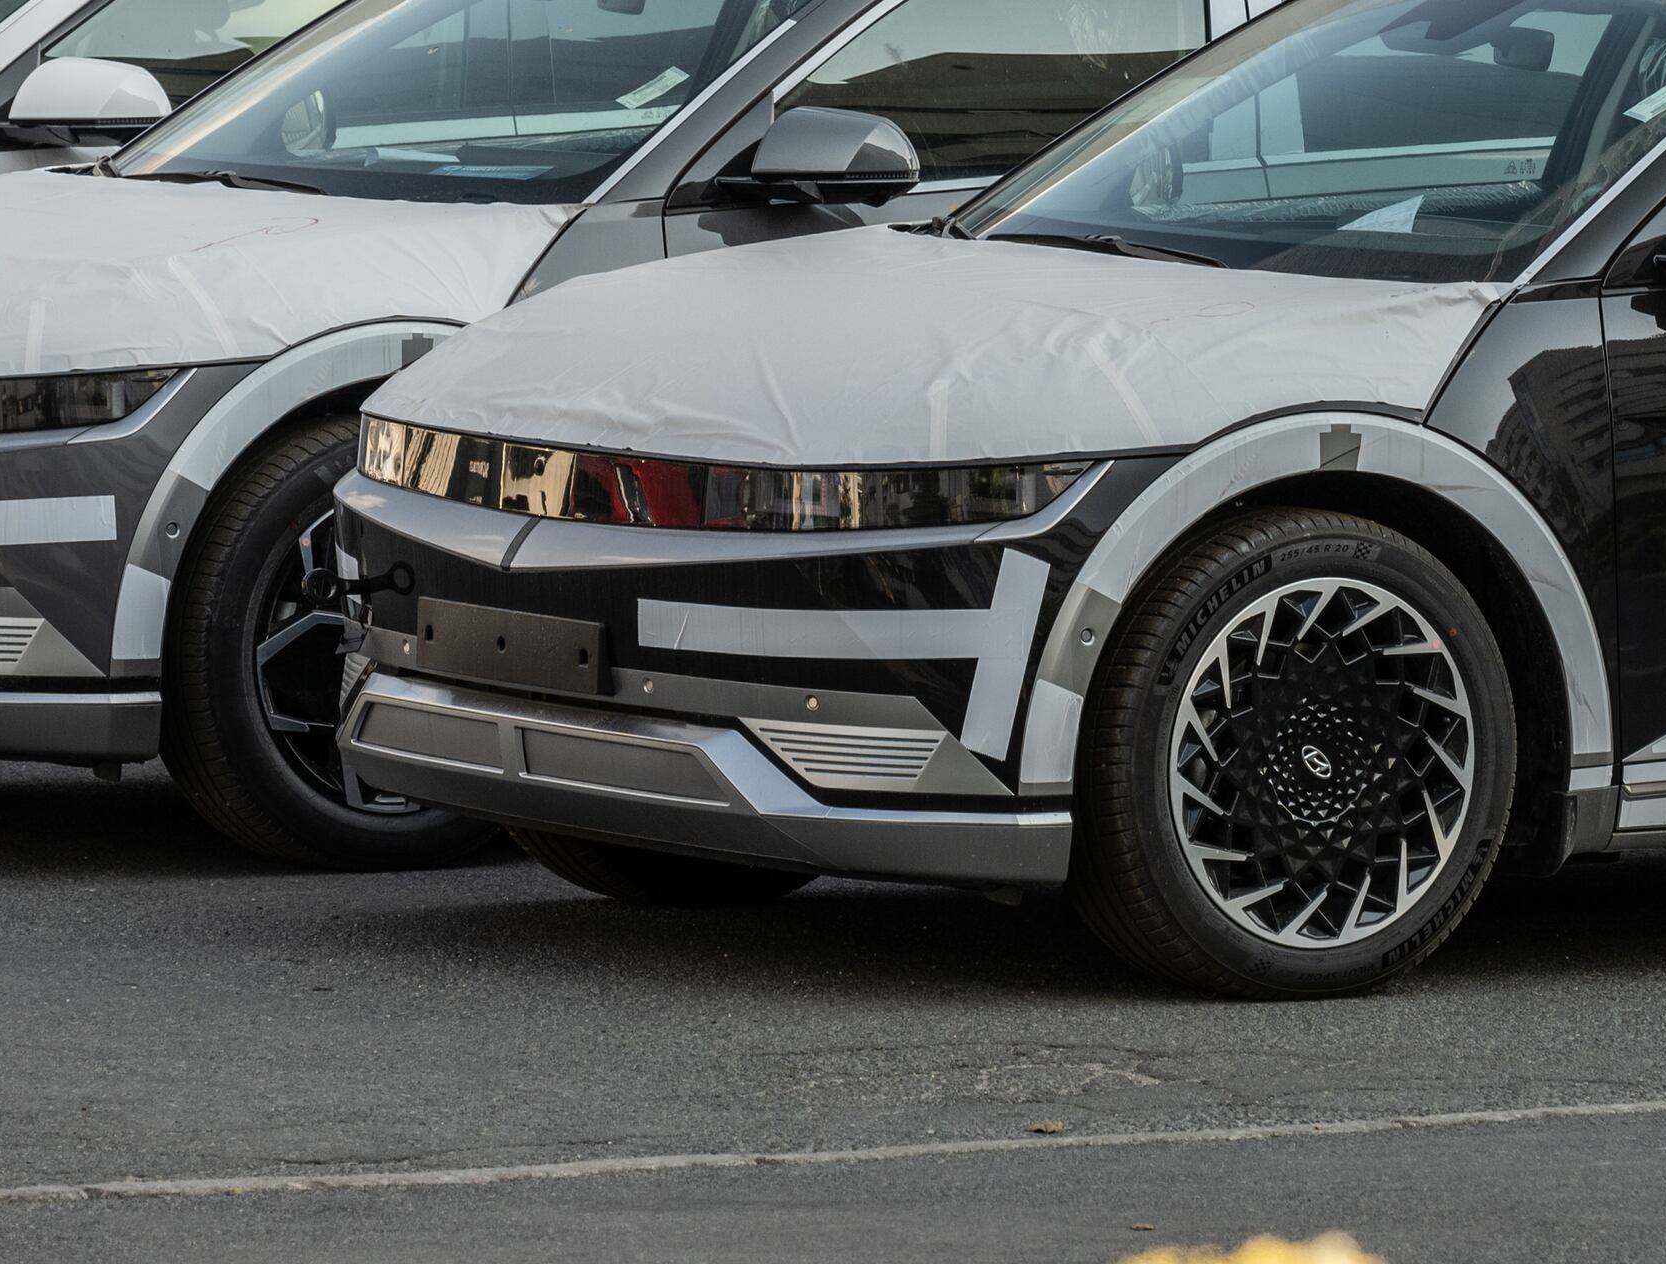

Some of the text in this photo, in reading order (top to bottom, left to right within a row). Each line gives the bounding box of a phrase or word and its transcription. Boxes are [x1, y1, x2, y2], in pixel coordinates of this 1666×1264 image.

[1175, 543, 1349, 658] MICHELIN 255/45 R 20
[1387, 866, 1476, 965] MICHELIN
